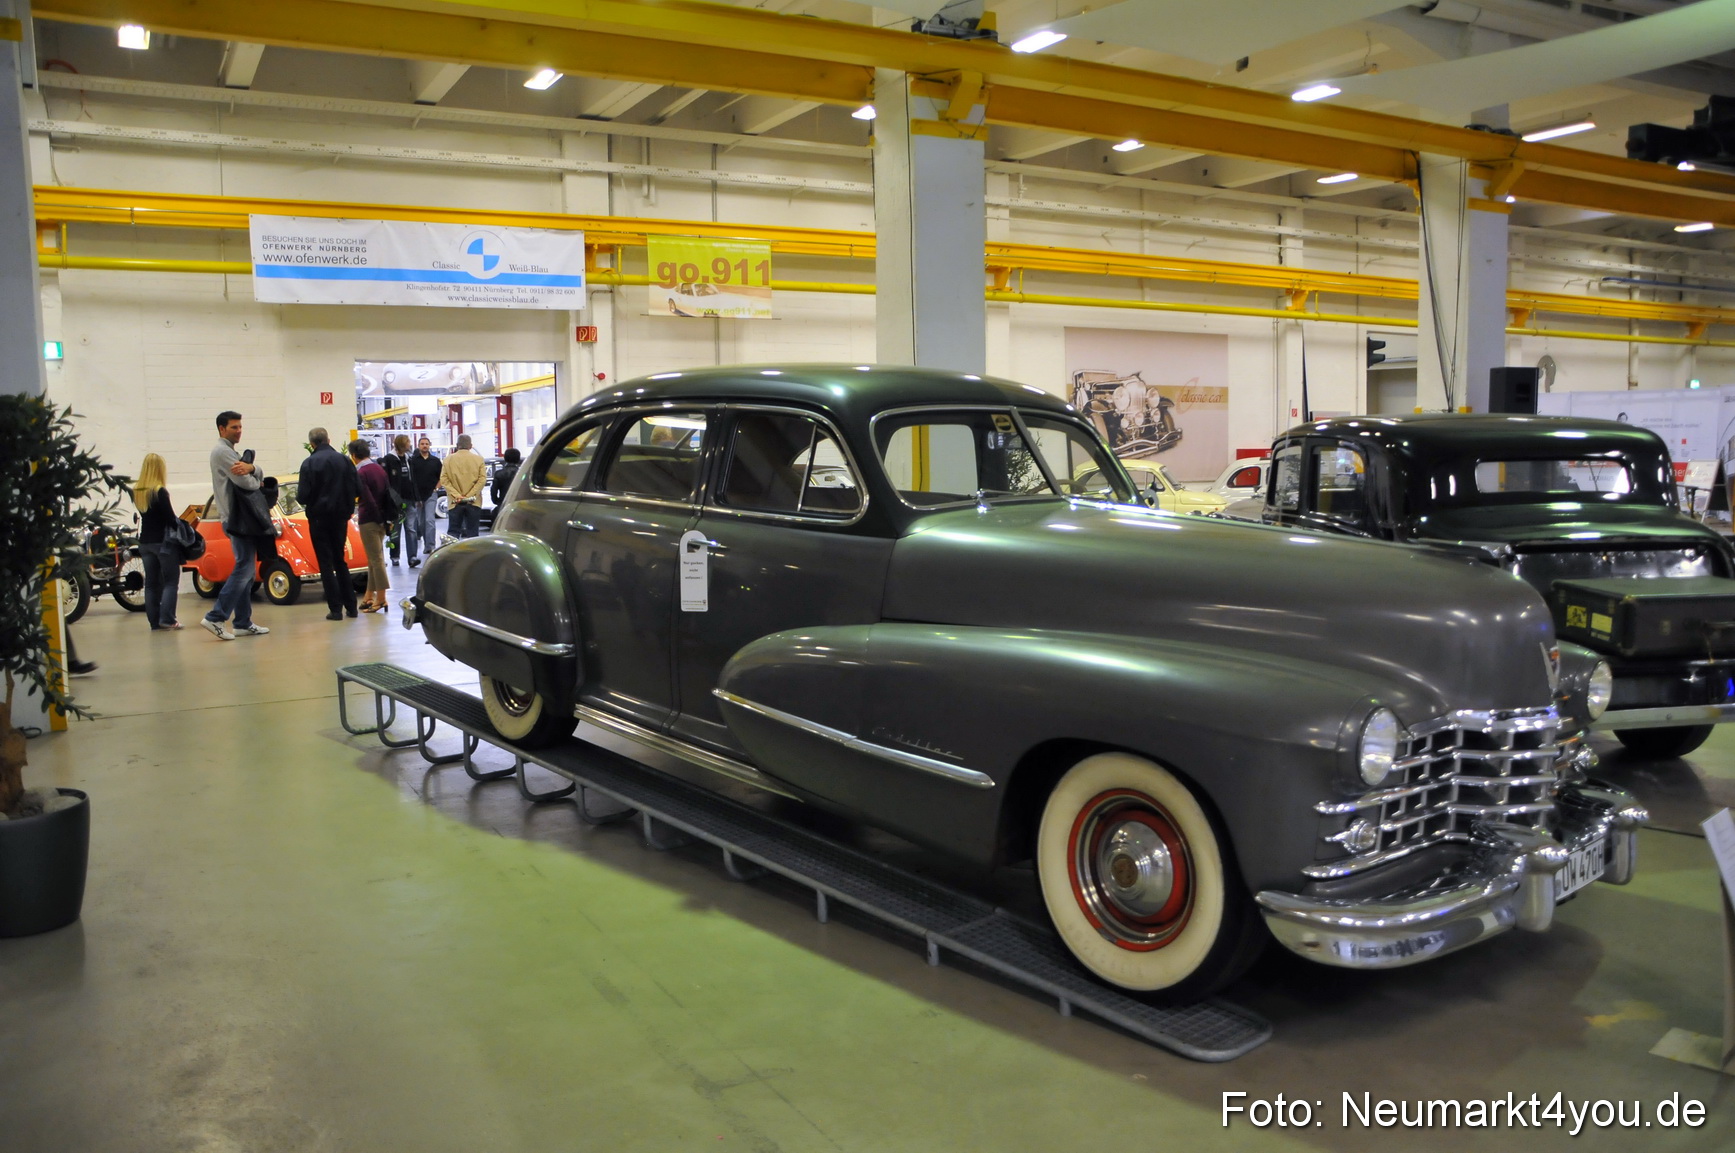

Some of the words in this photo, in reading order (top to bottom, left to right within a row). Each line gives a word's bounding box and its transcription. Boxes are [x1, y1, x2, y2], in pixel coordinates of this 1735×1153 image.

[262, 235, 304, 243] BESUCHEN
[262, 243, 313, 251] OFENWERK
[319, 244, 367, 253] NÜRNBERG
[263, 253, 368, 265] www.ofenwerk.de
[432, 260, 461, 270] Classic
[656, 257, 770, 289] go.911
[463, 285, 482, 293] 90411
[483, 286, 514, 294] Nürnberg
[447, 295, 540, 303] www.classicweissblau.de
